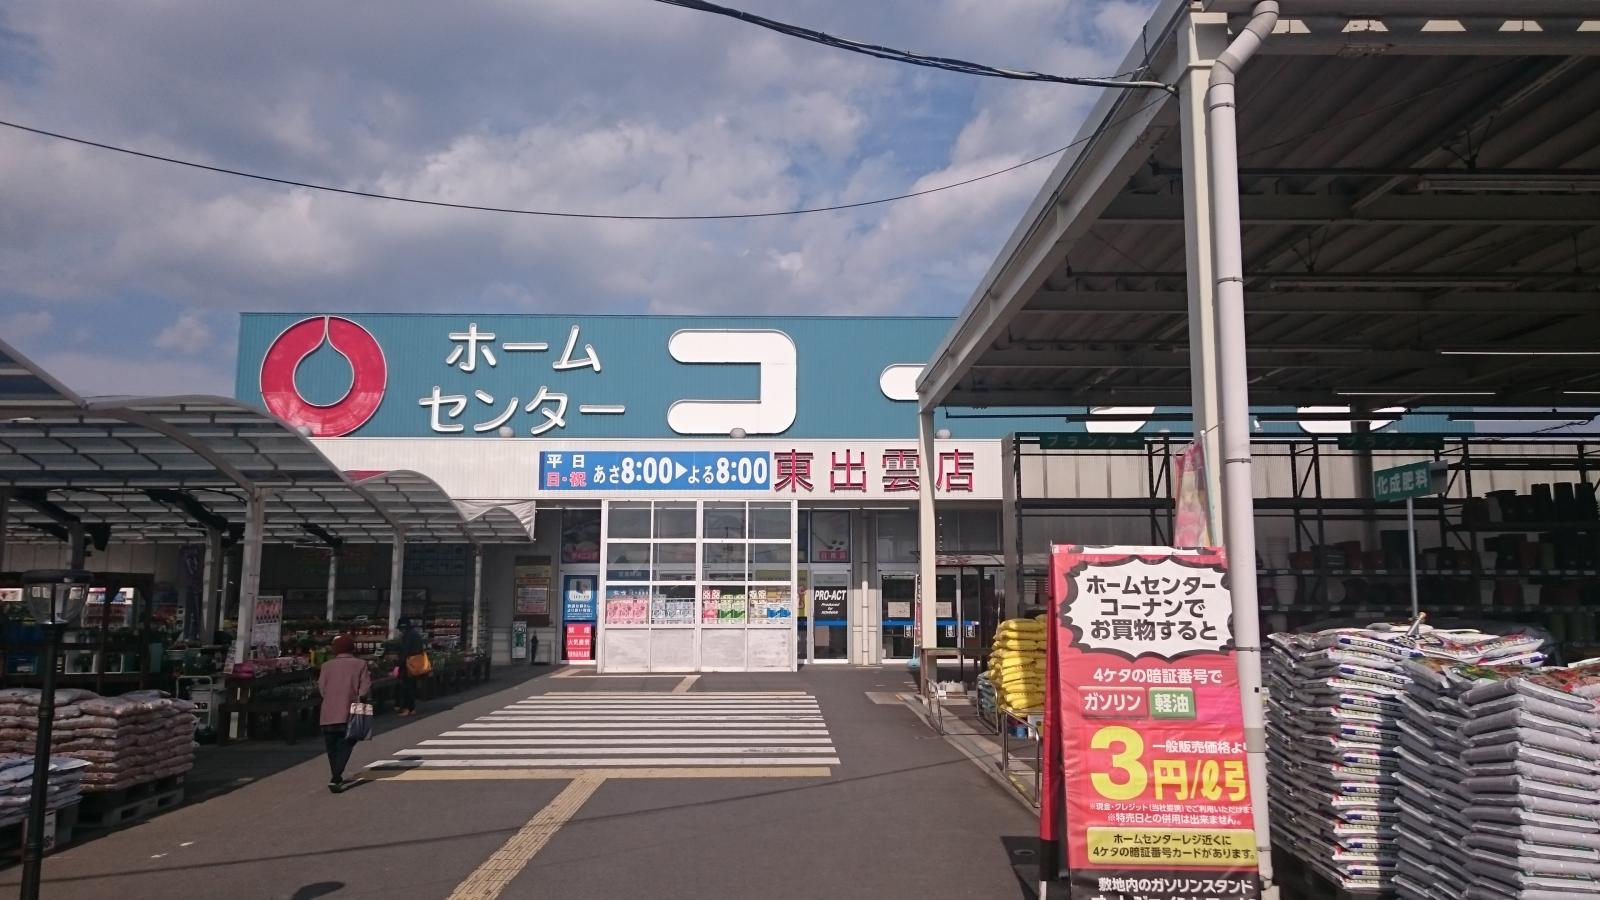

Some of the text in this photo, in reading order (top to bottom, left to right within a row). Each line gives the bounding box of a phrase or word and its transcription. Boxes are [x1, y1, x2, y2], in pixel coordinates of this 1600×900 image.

[446, 323, 601, 372] ホーム
[419, 386, 626, 435] センター
[546, 454, 585, 468] 平日
[774, 449, 975, 492] 東出雲店
[1377, 468, 1428, 495] 化成肥料
[814, 589, 847, 601] PRO-ACT
[1086, 575, 1216, 596] ホームセンター
[1100, 598, 1206, 618] コーナンで
[1090, 619, 1218, 641] お買物すると
[1093, 668, 1223, 684] 4ケタの暗証番号で
[1084, 692, 1190, 713] ガソリン 軽油
[1113, 834, 1232, 846] ホームセンターレジ近くに
[1092, 847, 1255, 859] 4ケタの暗証番号カードがあります。
[1098, 877, 1254, 894] 敷地内のガソリンスタンド
